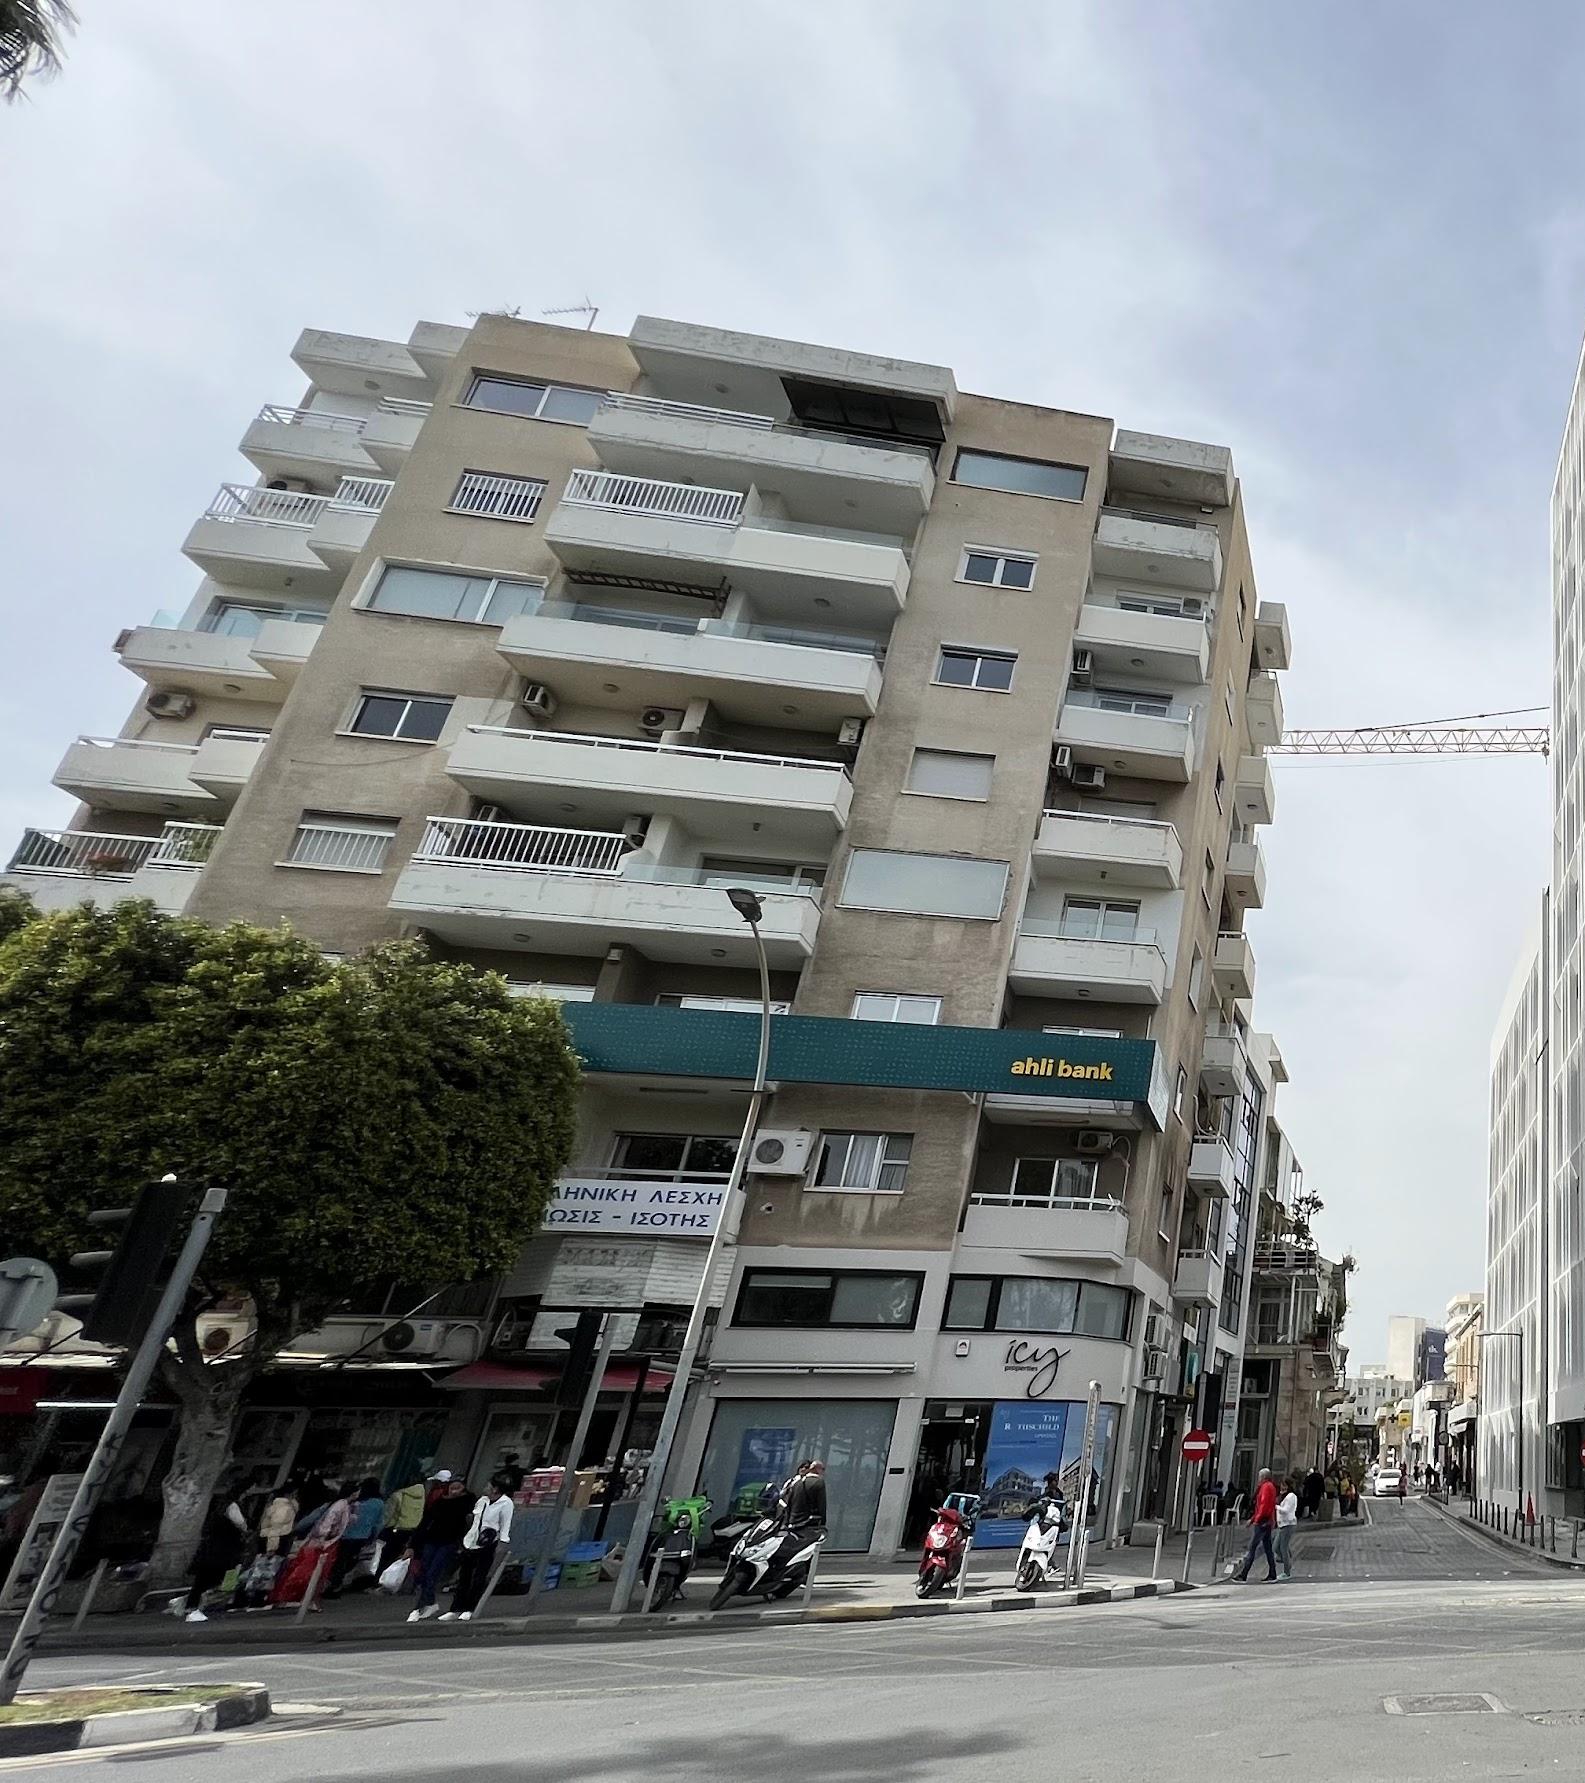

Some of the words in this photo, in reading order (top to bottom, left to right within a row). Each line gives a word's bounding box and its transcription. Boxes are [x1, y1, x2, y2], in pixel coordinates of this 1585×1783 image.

[1011, 1057, 1054, 1076] ahli
[1058, 1060, 1113, 1080] bank
[650, 1190, 722, 1205] ΛΕΣΧΗ
[631, 1212, 710, 1227] ΙΣΟΤΗΣ
[1006, 1340, 1071, 1398] icy
